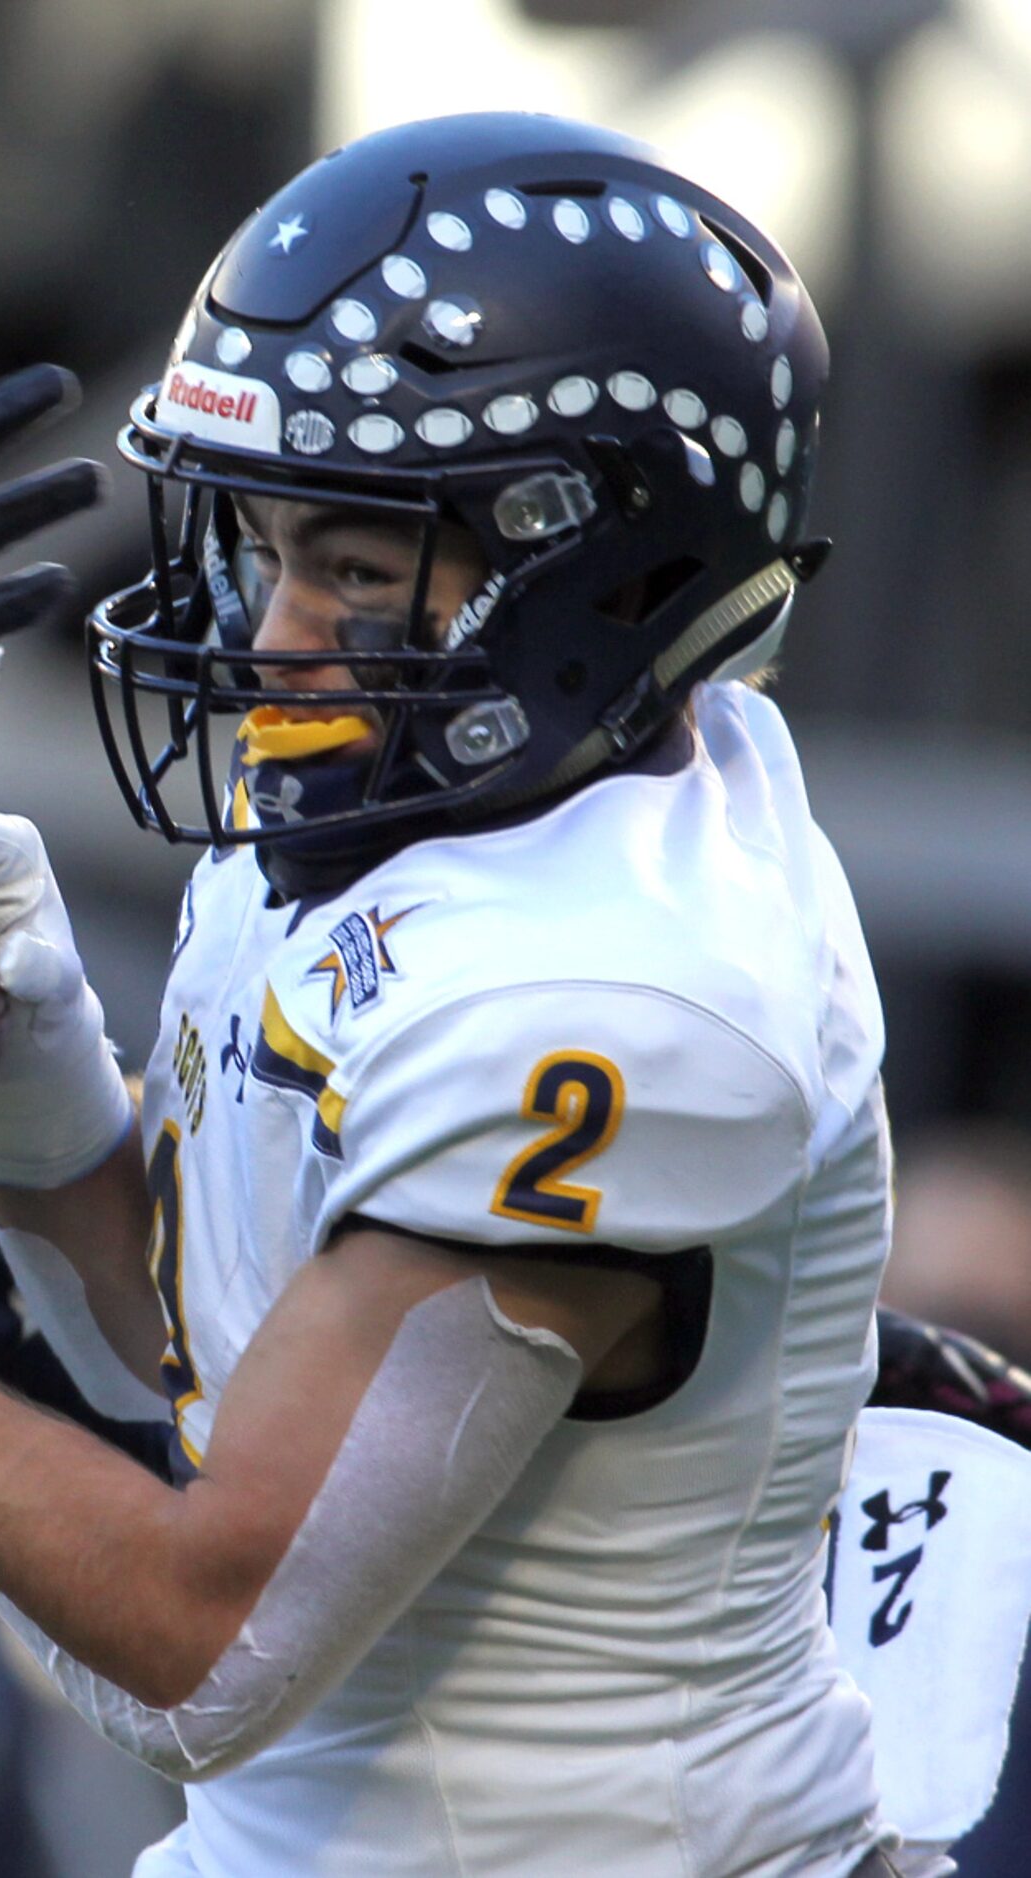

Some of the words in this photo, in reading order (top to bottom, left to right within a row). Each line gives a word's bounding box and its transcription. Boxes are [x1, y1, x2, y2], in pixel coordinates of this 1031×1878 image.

[168, 371, 258, 424] Riddell
[445, 570, 507, 651] ddell
[489, 1048, 626, 1234] 2
[867, 1543, 924, 1648] 2
